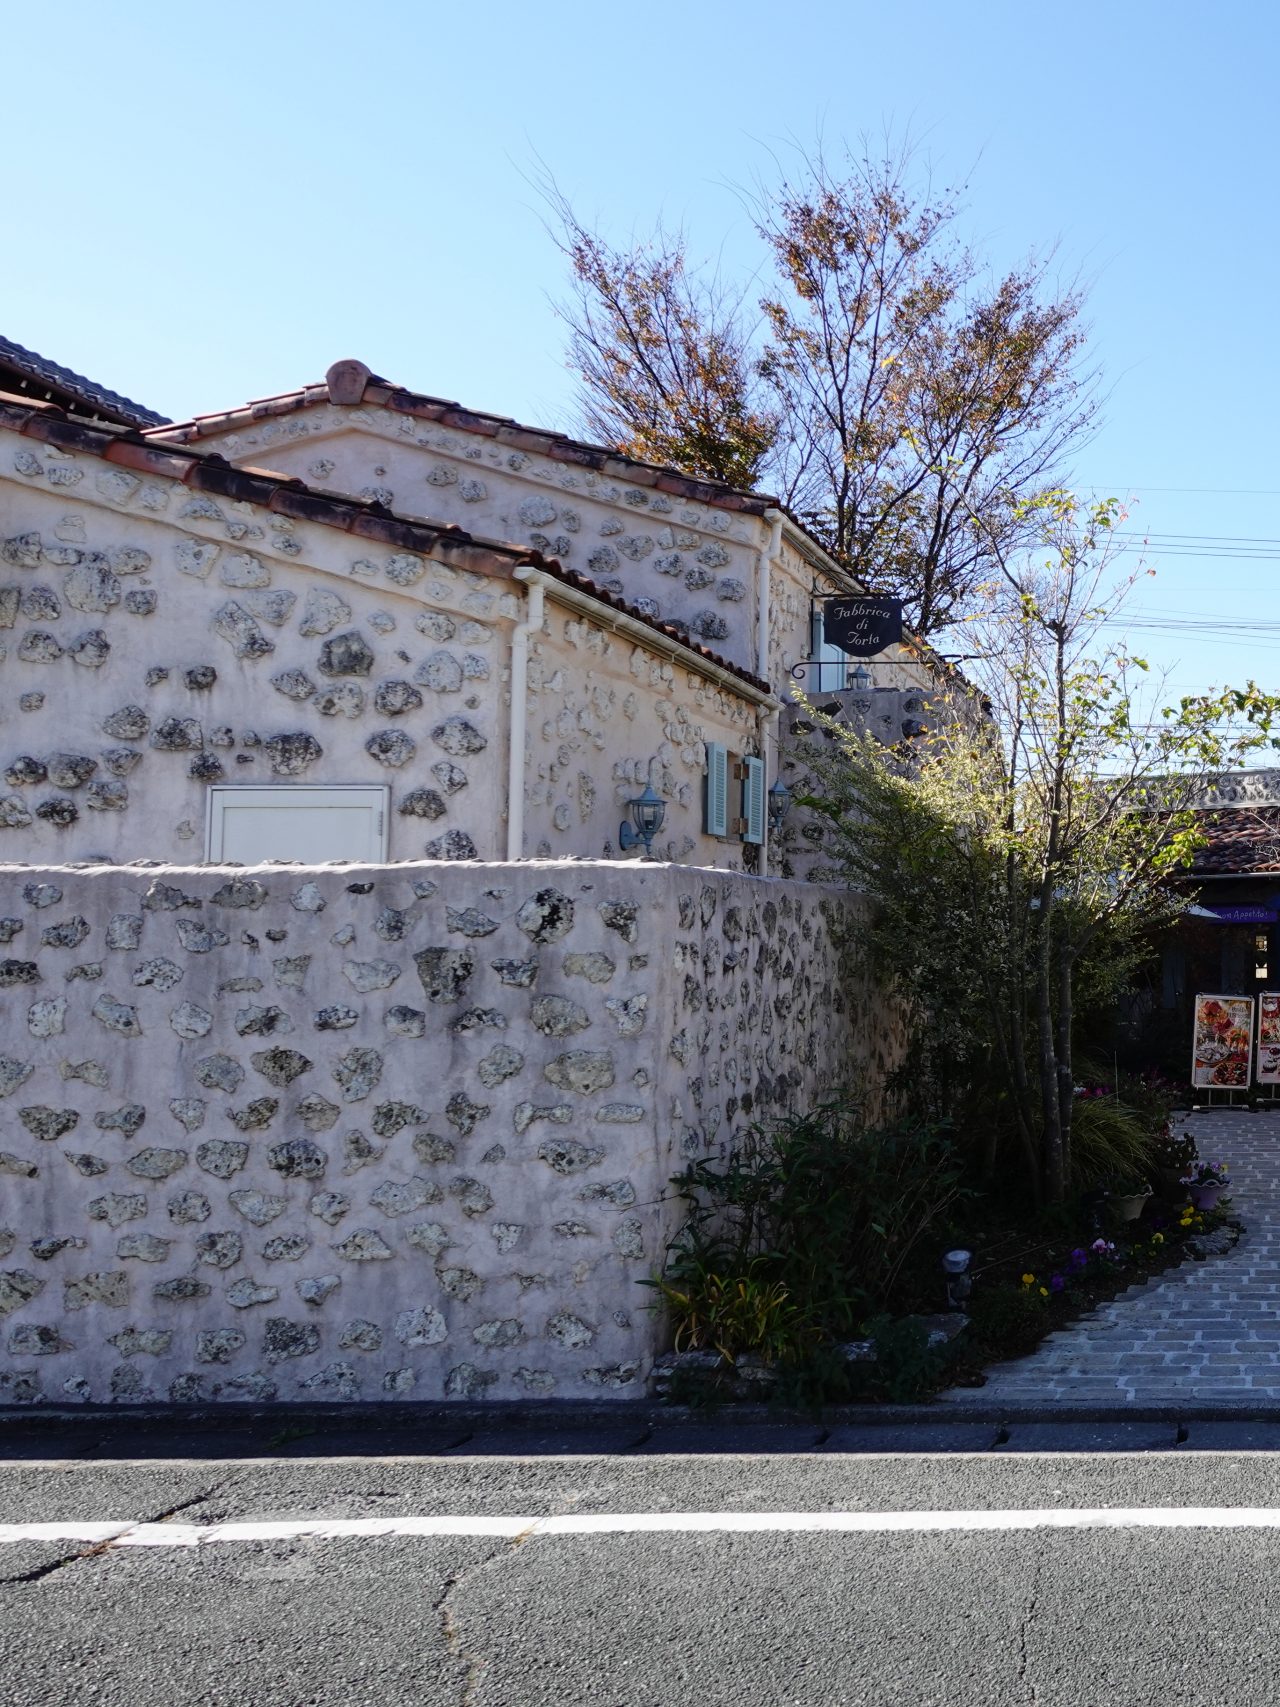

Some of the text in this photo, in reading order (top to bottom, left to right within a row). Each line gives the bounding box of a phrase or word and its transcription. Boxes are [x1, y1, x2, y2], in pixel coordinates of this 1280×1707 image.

[833, 603, 891, 620] Fabbrica
[856, 618, 869, 630] di
[847, 631, 880, 646] Torta
